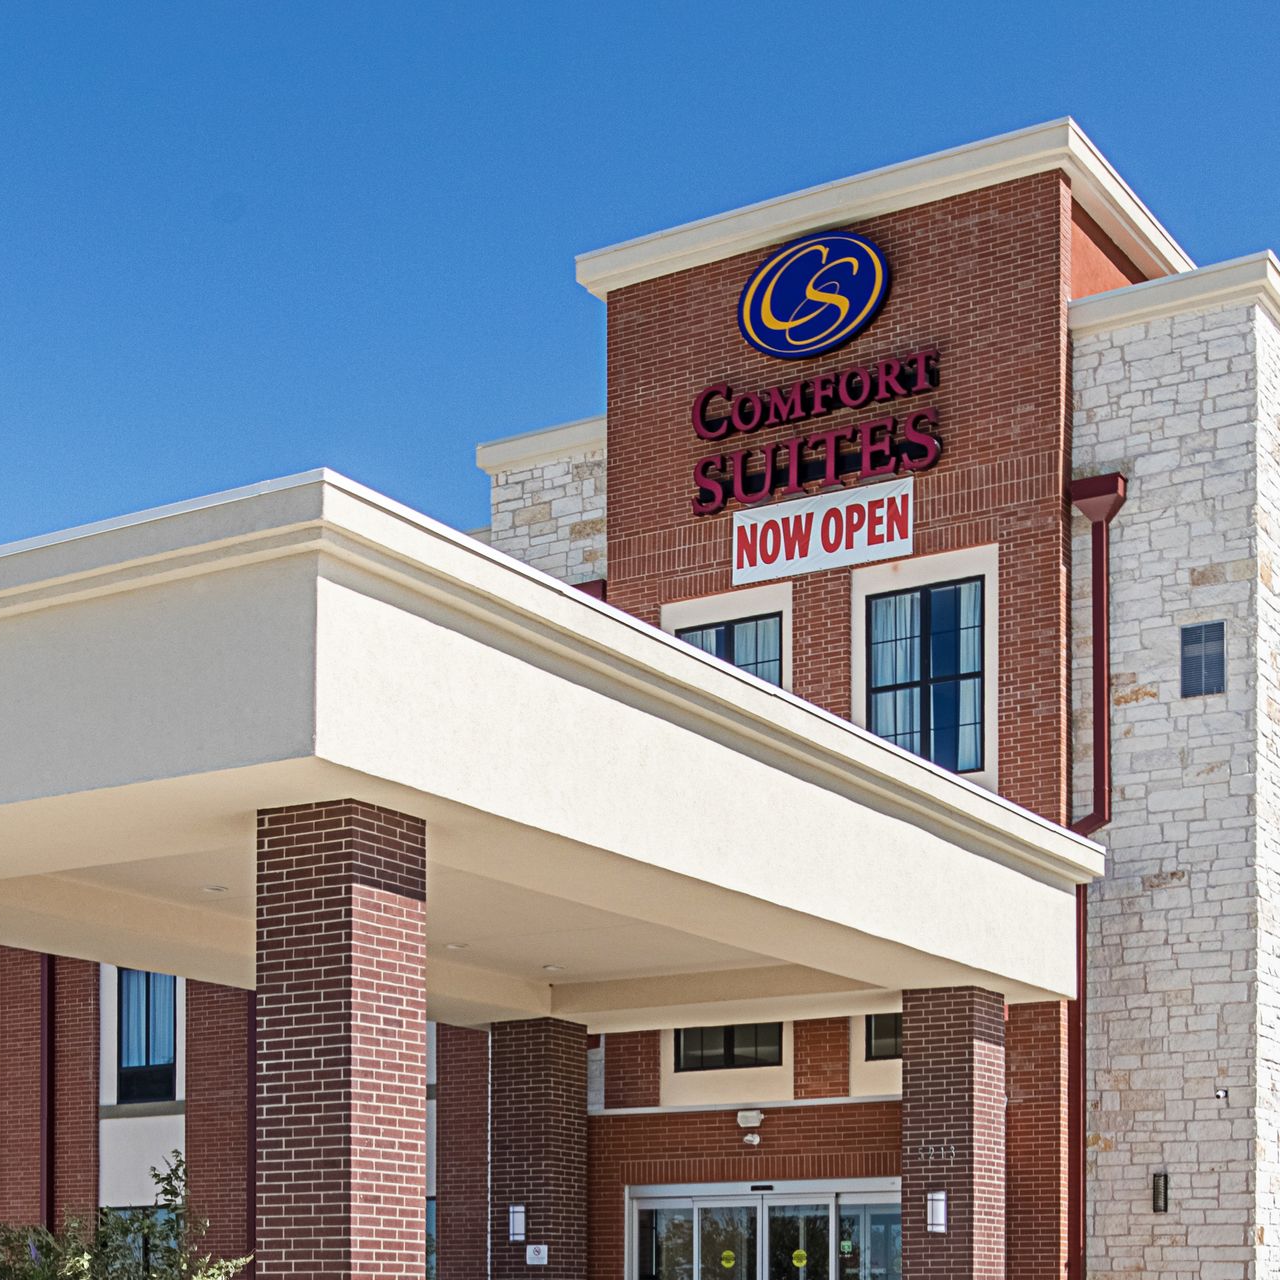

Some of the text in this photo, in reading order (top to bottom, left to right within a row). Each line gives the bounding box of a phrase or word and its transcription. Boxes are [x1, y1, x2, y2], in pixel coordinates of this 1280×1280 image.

[692, 350, 940, 441] COMFORT
[692, 408, 942, 515] SUITES
[737, 493, 910, 570] NOW OPEN
